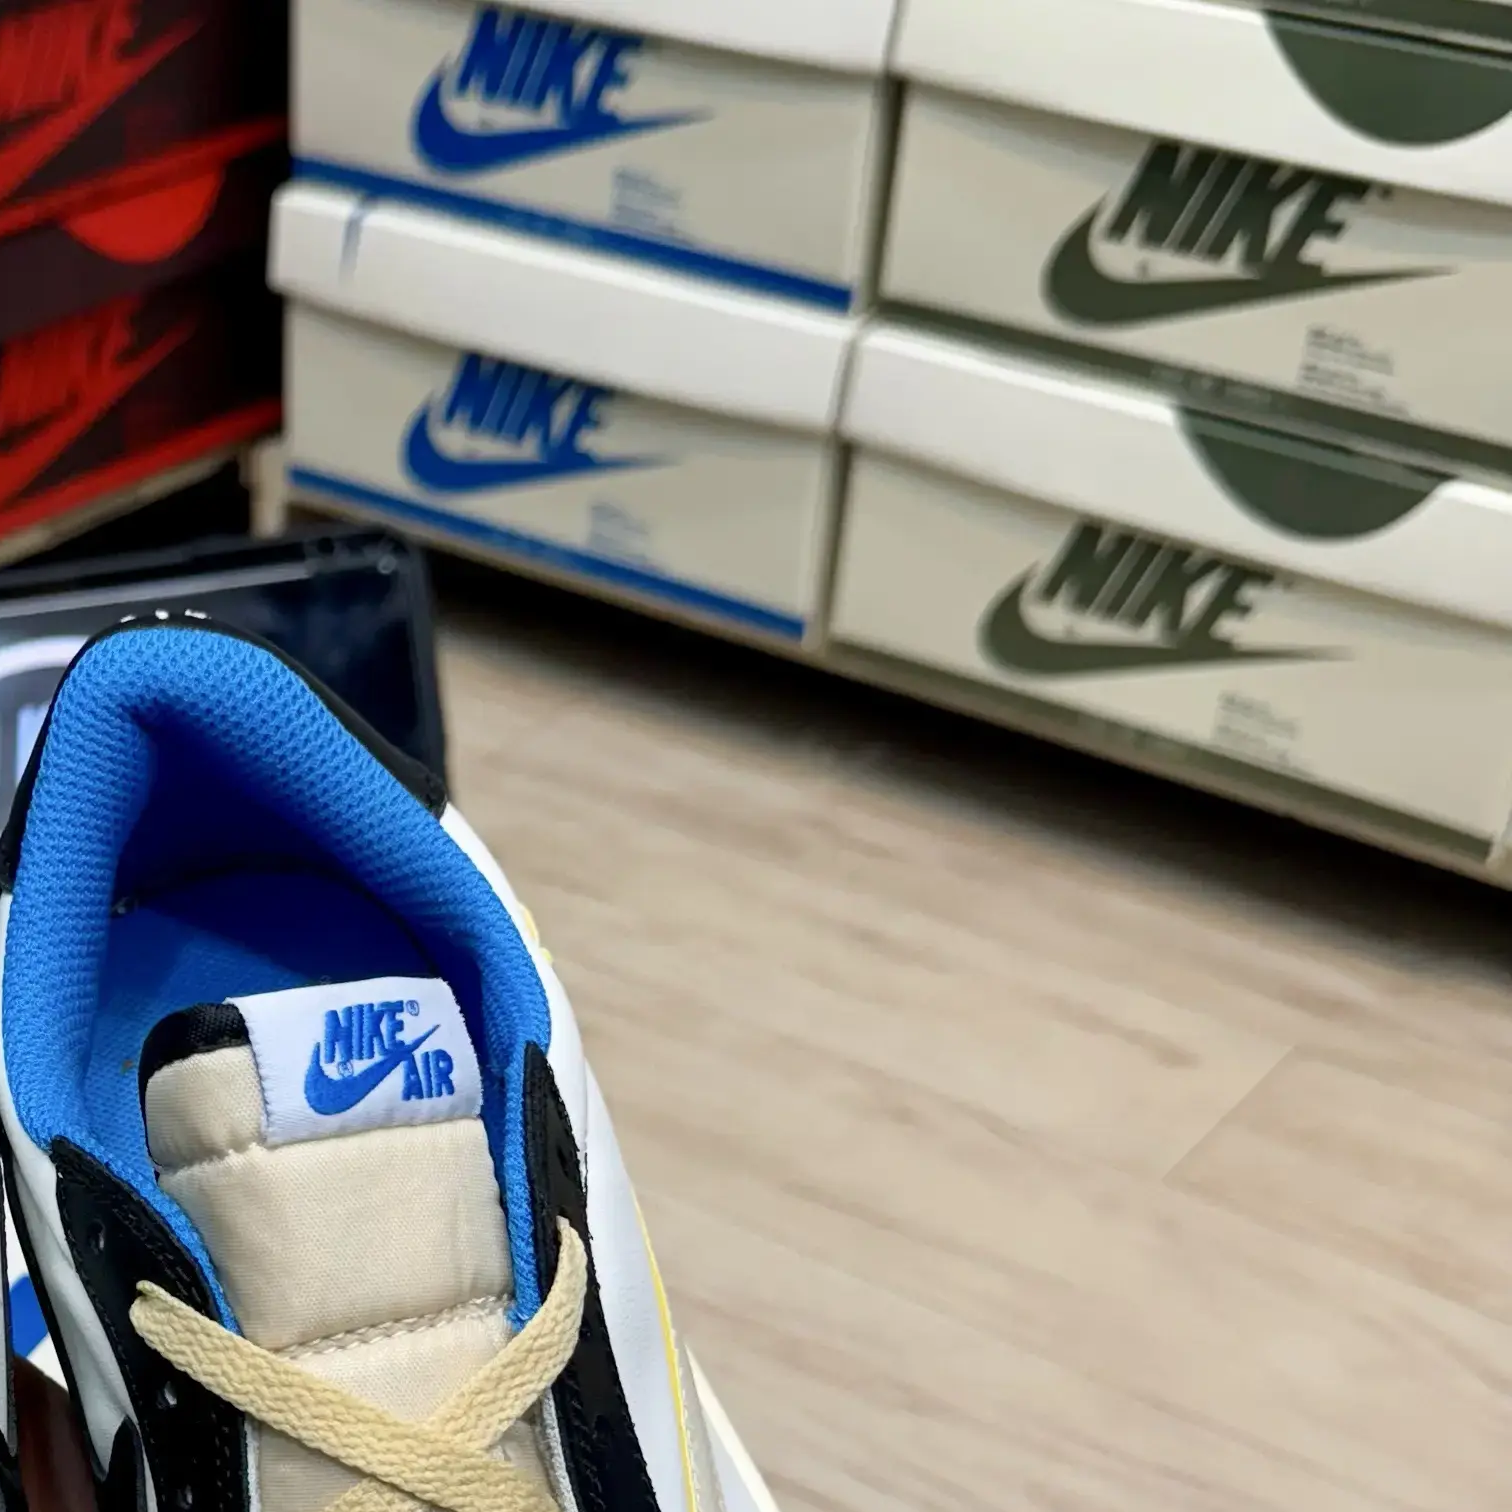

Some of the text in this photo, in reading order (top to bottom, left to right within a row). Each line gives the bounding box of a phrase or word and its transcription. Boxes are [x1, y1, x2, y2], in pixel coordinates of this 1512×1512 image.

[457, 8, 643, 124] NIKE
[1104, 139, 1372, 274] NIKE
[445, 353, 615, 460] NIKE
[1036, 520, 1274, 648] NIKE
[323, 1001, 405, 1064] NIKE
[402, 1049, 454, 1101] AIR
